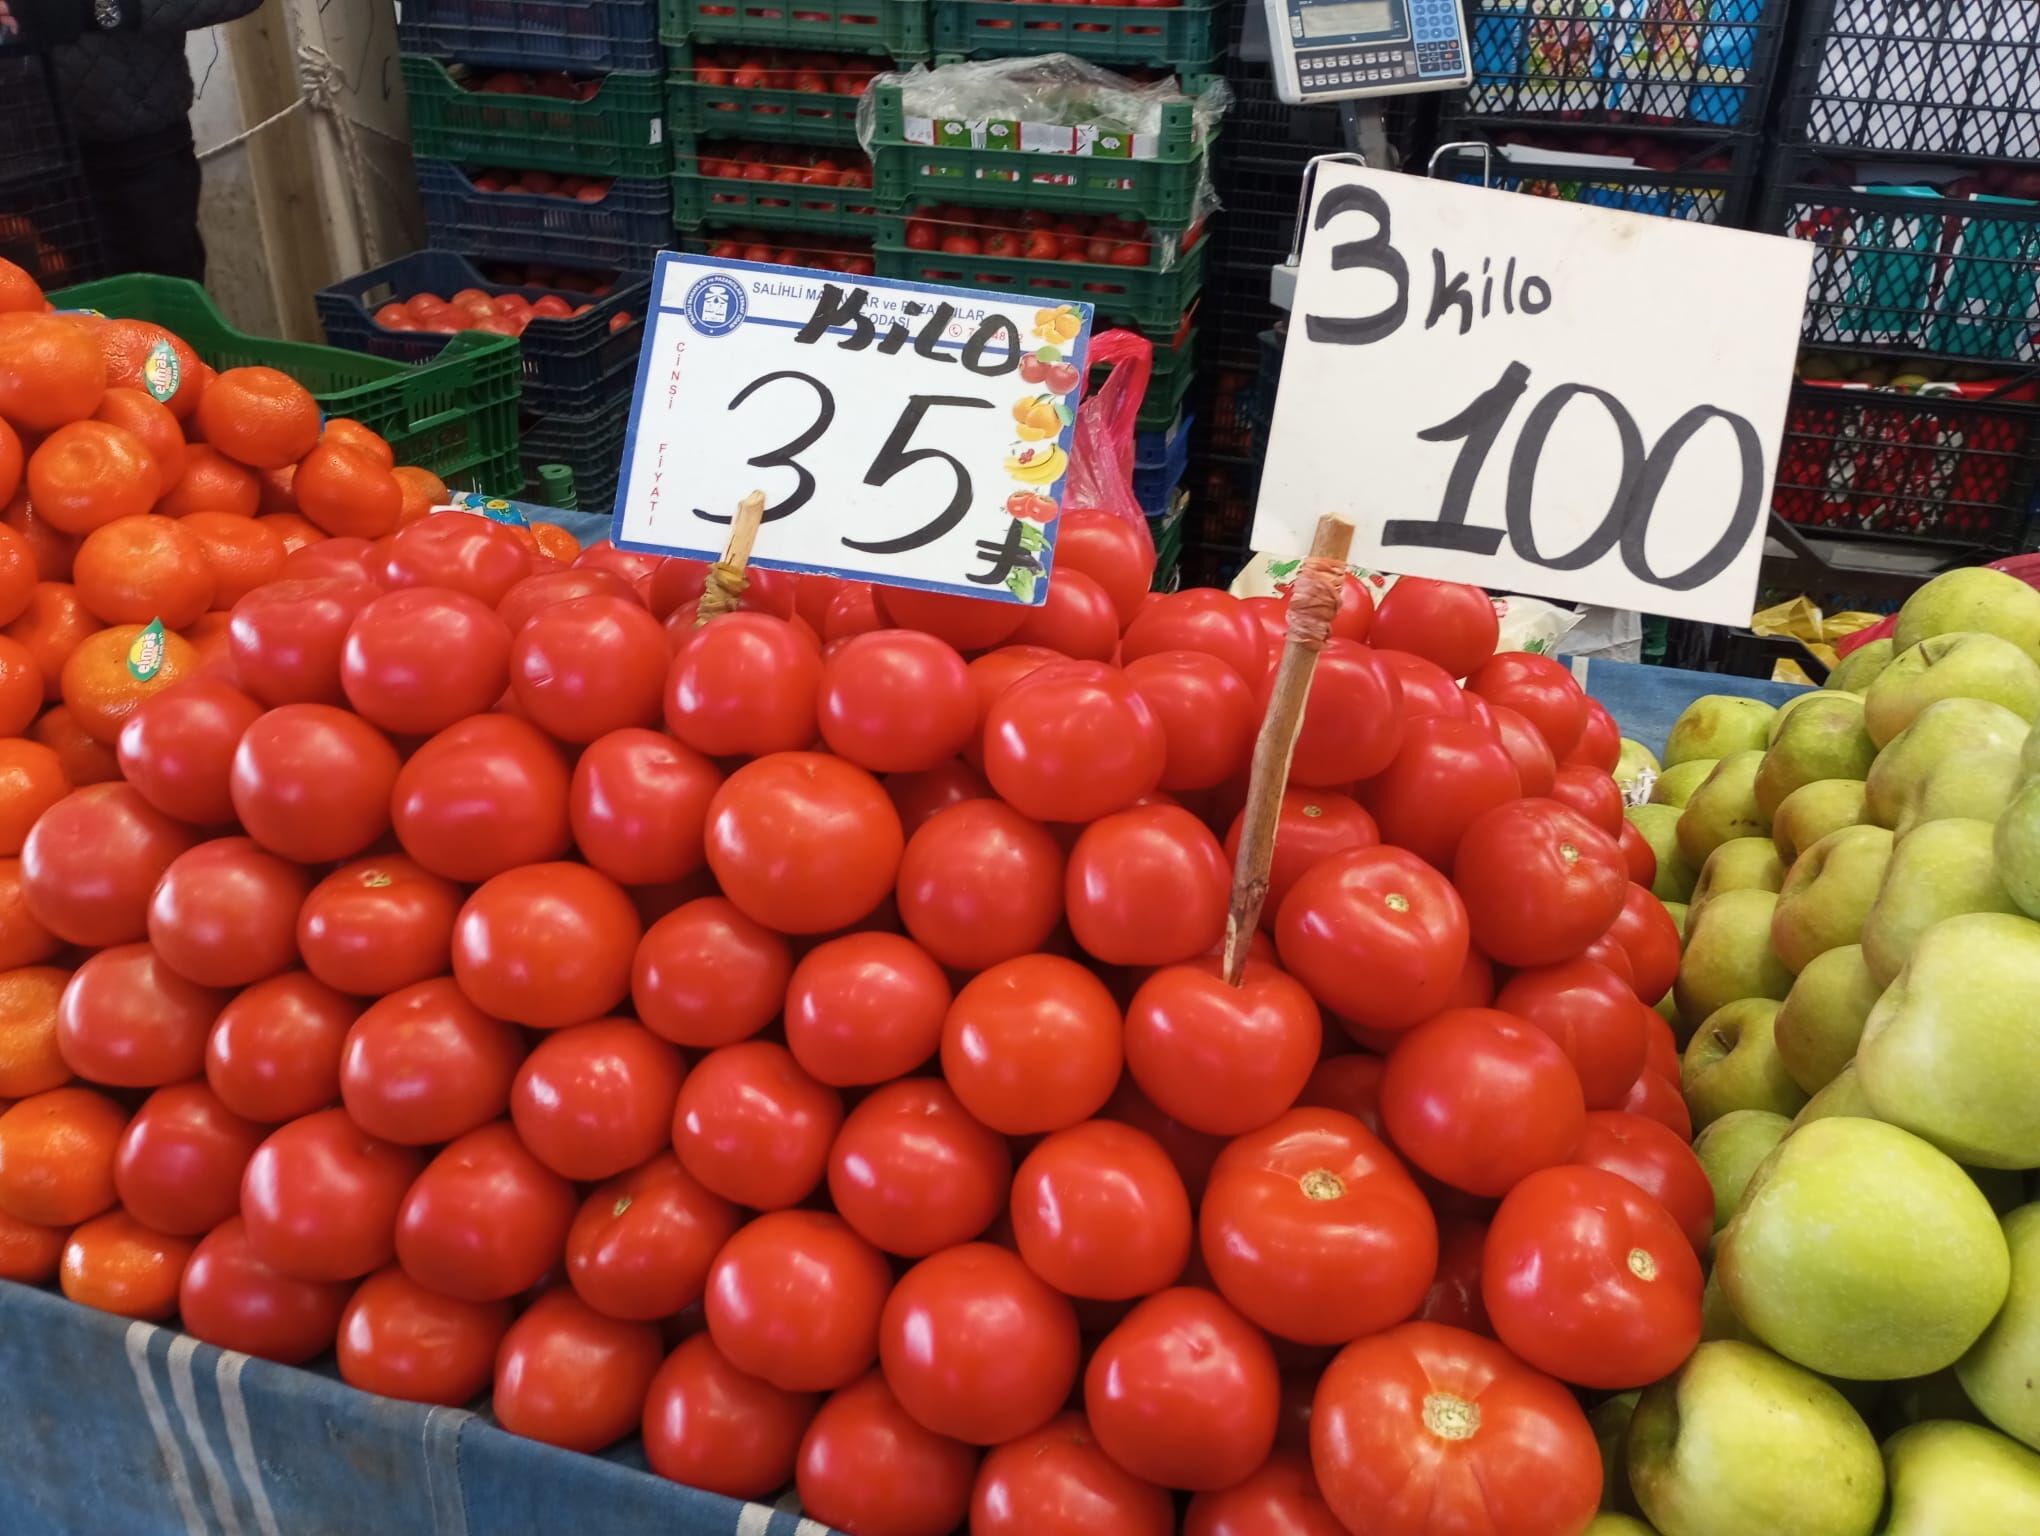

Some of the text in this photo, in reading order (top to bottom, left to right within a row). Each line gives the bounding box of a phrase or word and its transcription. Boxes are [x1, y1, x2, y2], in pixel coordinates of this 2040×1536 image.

[752, 282, 803, 299] SALİHLİ
[883, 300, 897, 311] ve
[1306, 183, 1553, 345] 3 kilo
[692, 370, 996, 554] 35
[1381, 360, 1764, 591] 100
